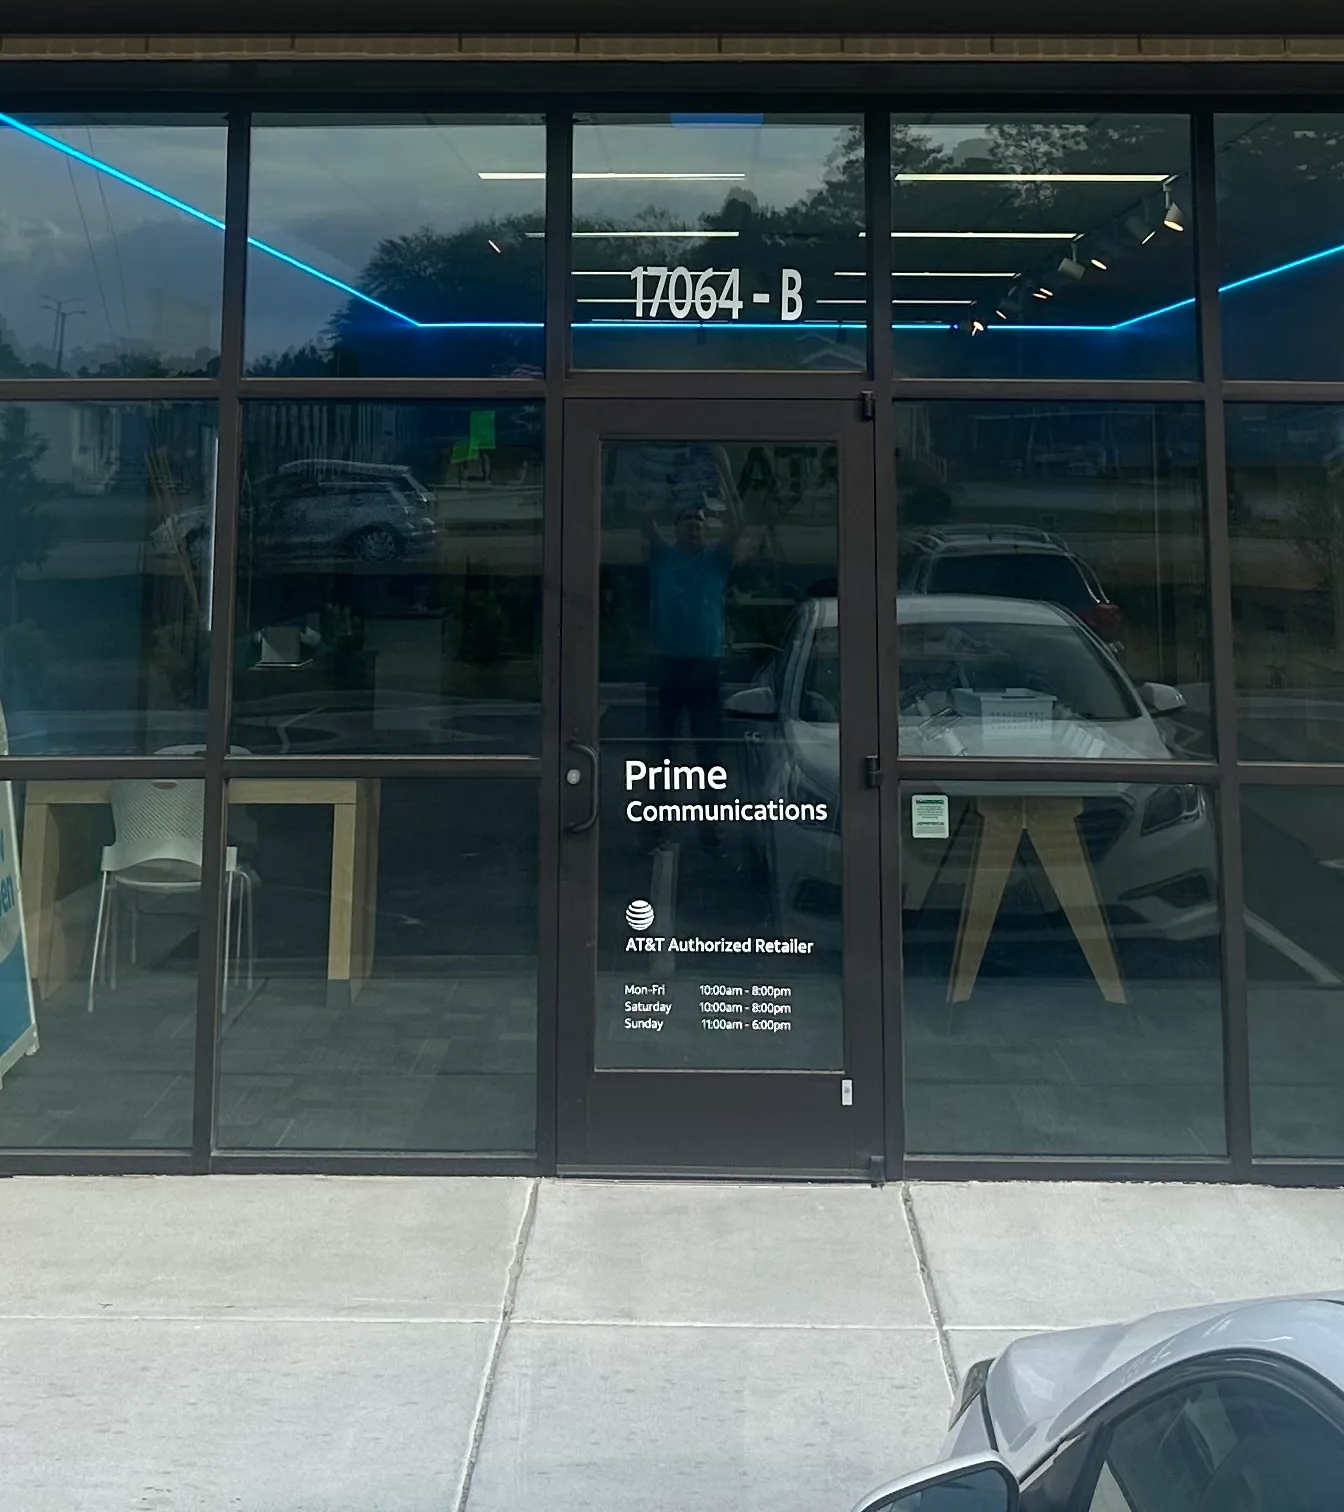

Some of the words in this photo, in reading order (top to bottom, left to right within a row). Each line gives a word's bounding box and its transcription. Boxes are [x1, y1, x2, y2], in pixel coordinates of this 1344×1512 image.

[630, 266, 744, 320] 17064
[781, 268, 803, 321] B
[625, 758, 728, 791] Prime
[626, 798, 828, 822] Communications
[625, 937, 666, 952] AT&T
[667, 936, 752, 953] Authorized
[755, 938, 815, 954] Retailer
[624, 983, 666, 996] Mon-Fri
[699, 984, 743, 996] 10:00am
[751, 985, 792, 999] 8:00pm
[624, 1000, 672, 1015] Saturday
[698, 1001, 743, 1013] 10:00am
[751, 1002, 792, 1016] 8:00pm
[624, 1017, 664, 1032] Sunday
[701, 1018, 743, 1030] 11:00am
[751, 1019, 792, 1033] 6:00pm
